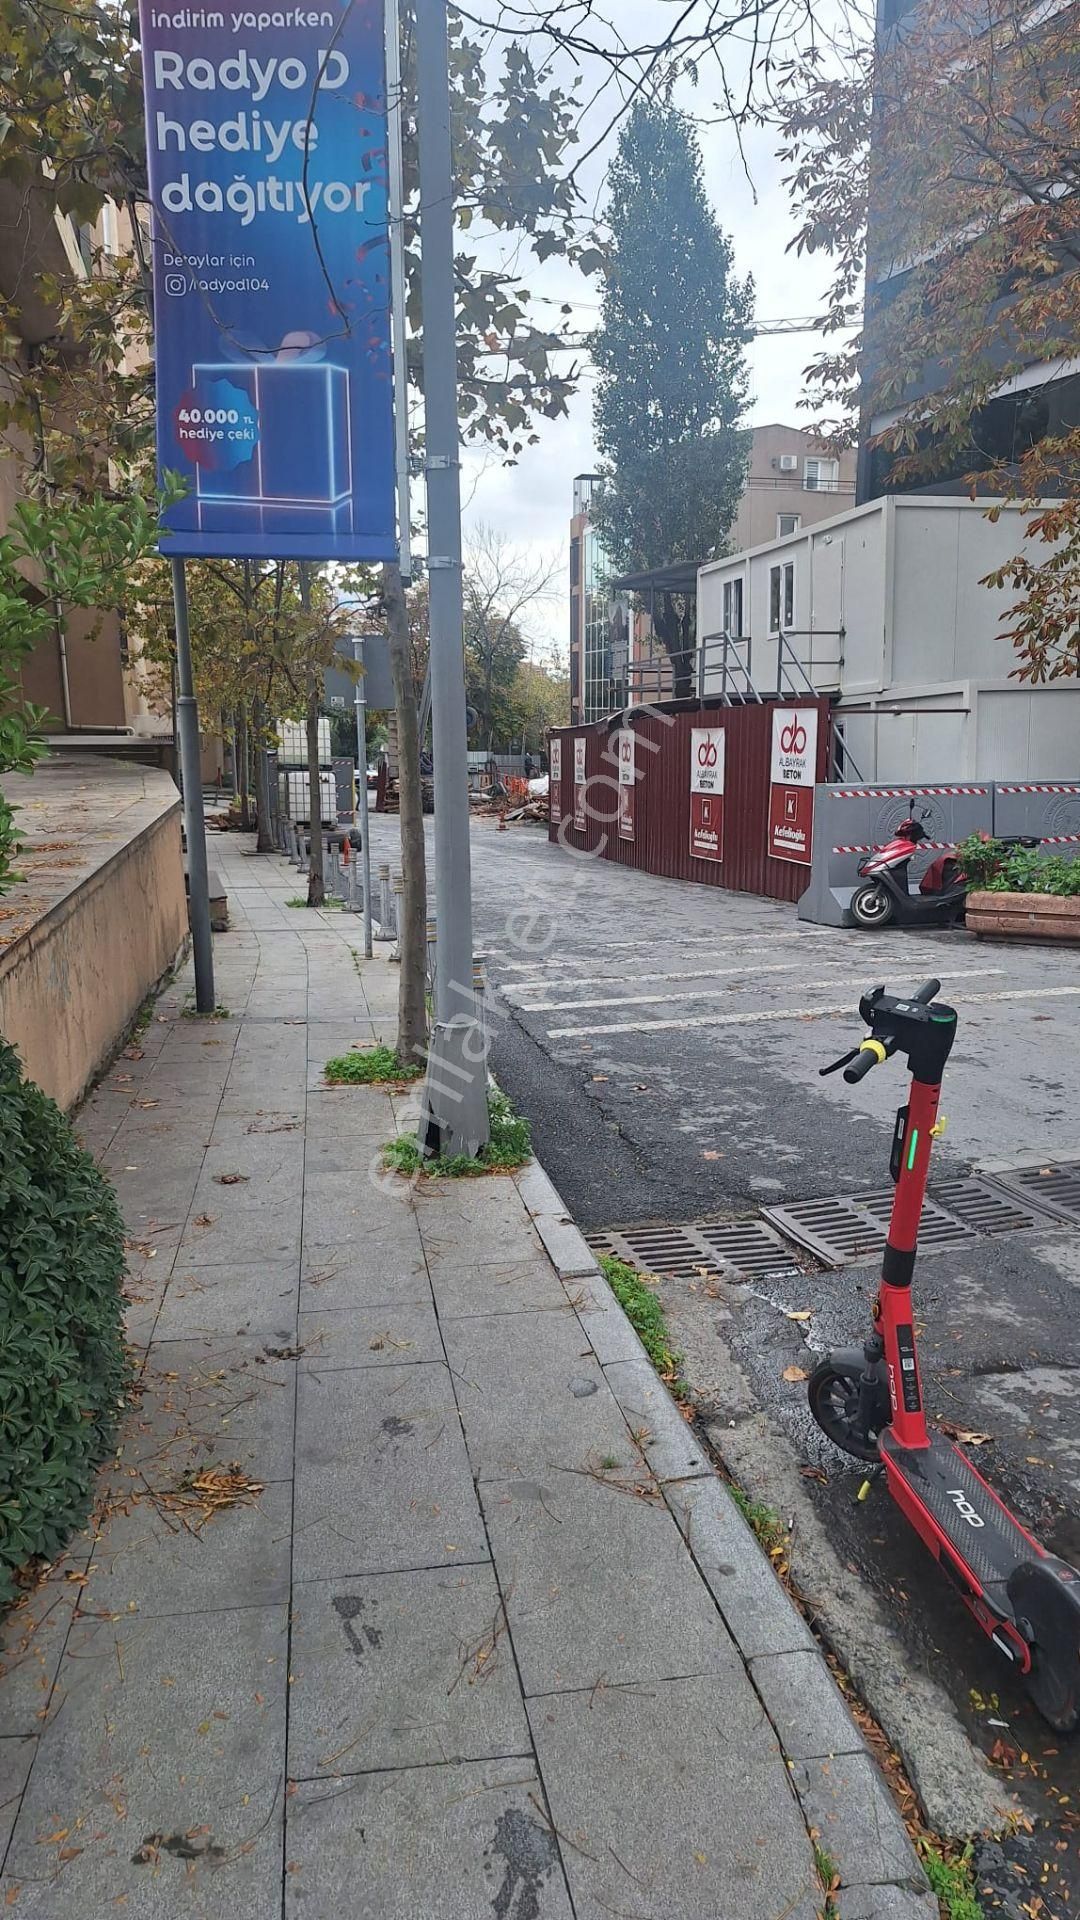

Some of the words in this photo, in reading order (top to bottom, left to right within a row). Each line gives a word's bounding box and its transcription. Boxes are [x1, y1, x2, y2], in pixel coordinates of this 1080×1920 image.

[151, 9, 225, 29] indirim
[231, 8, 333, 32] yaparken
[154, 50, 307, 101] Radyo
[317, 50, 349, 90] D
[156, 111, 319, 163] hediye
[161, 173, 372, 226] dağıtıyor
[229, 254, 255, 269] için
[178, 408, 239, 424] 40.000
[243, 416, 254, 424] TL
[180, 428, 224, 442] hediye
[227, 429, 255, 441] çeki
[783, 769, 802, 780] BETON
[946, 1489, 985, 1528] hop
